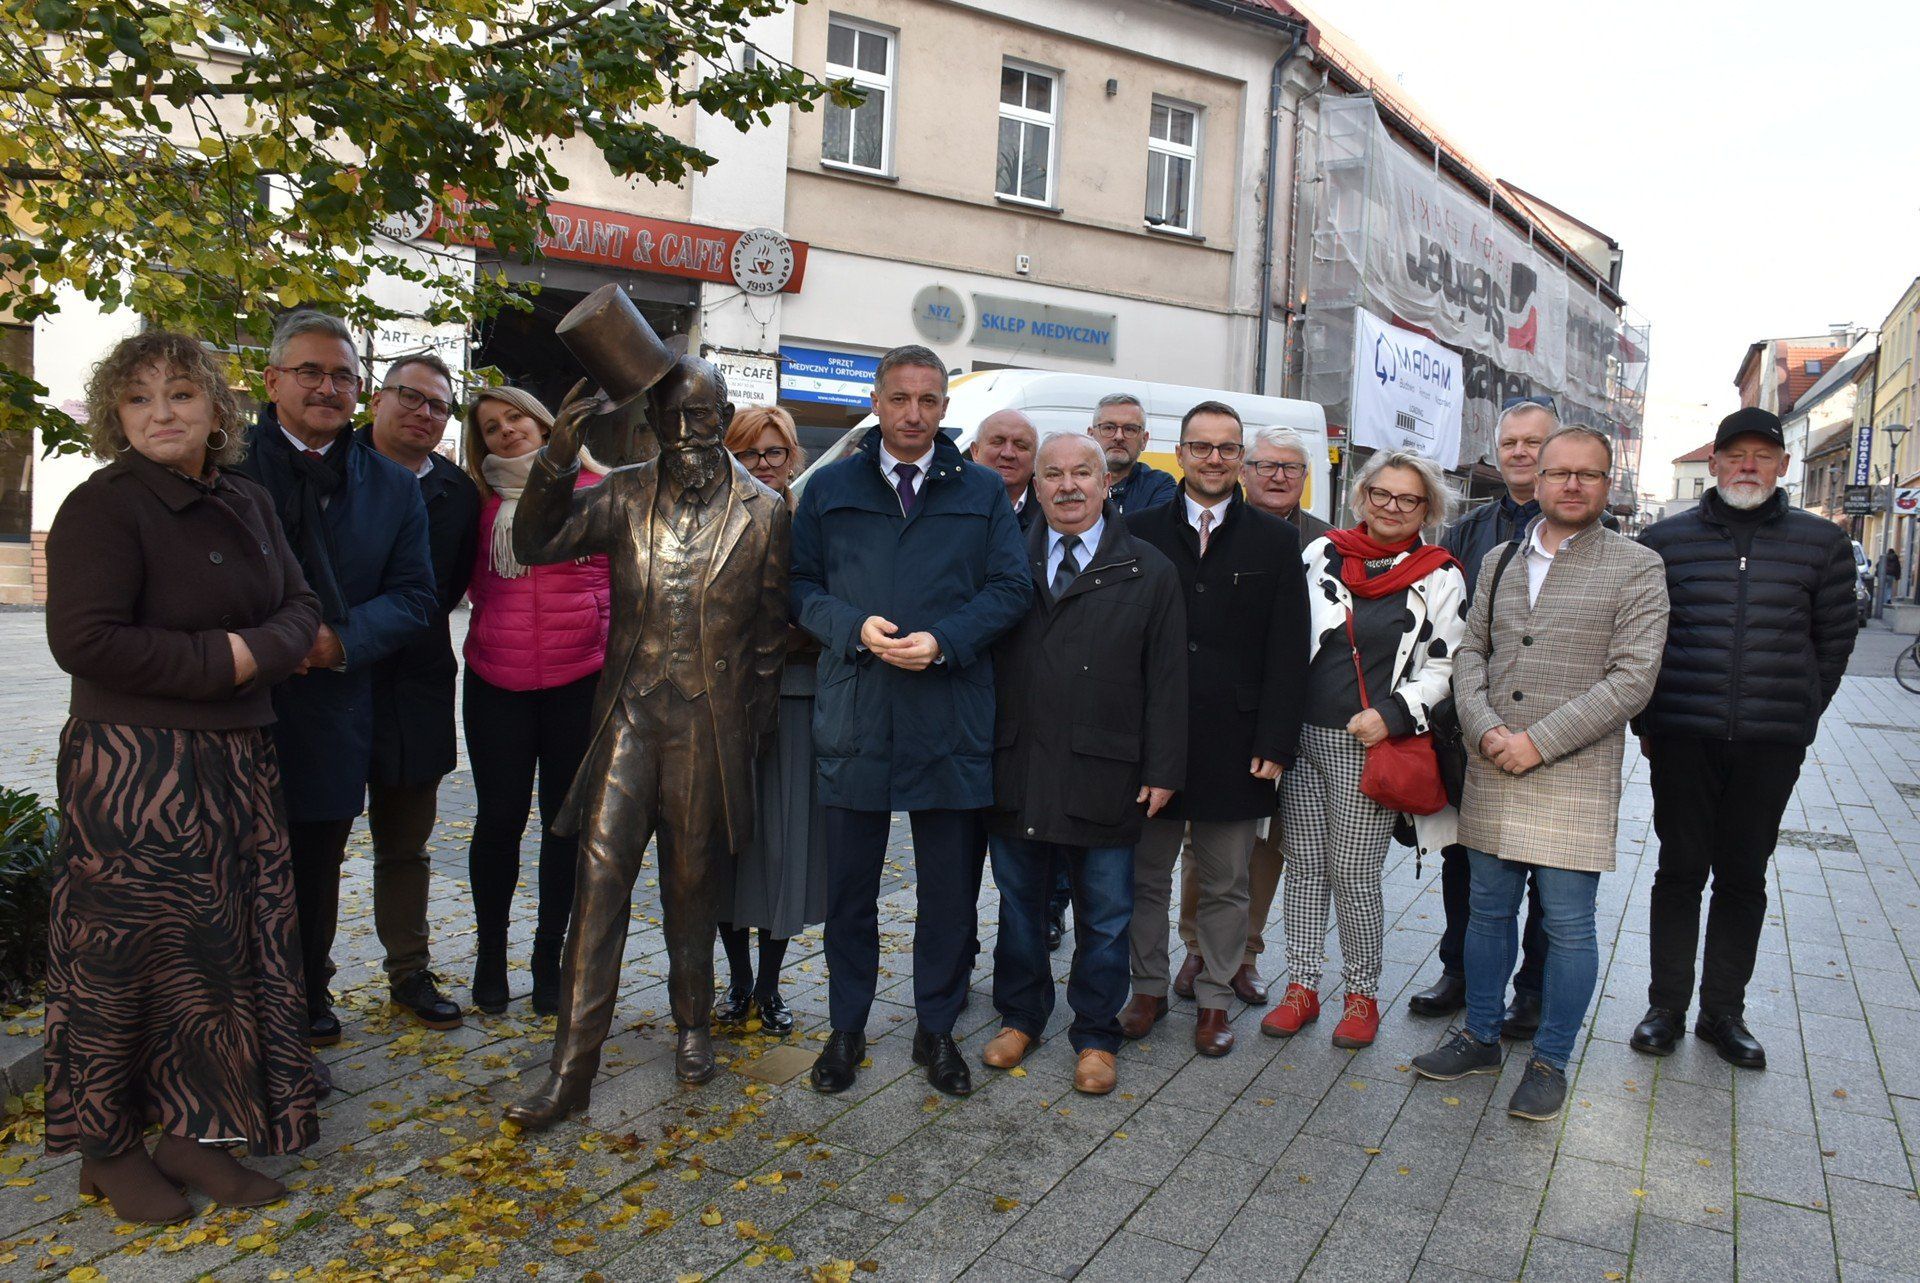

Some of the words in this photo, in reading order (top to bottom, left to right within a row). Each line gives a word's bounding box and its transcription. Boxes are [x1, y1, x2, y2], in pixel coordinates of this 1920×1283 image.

[633, 229, 655, 263] &
[746, 280, 774, 292] 1993
[381, 330, 410, 343] ART
[982, 312, 1025, 333] SKLEP
[1031, 320, 1110, 345] MEDYCZNY
[789, 362, 829, 374] MEDYCZNY
[835, 367, 876, 379] ORTOPEDYC
[828, 357, 854, 368] SPRZĘT
[1395, 342, 1451, 391] MADAM
[714, 363, 734, 375] RT
[743, 366, 773, 380] CAFÉ
[743, 391, 765, 400] POLSKA
